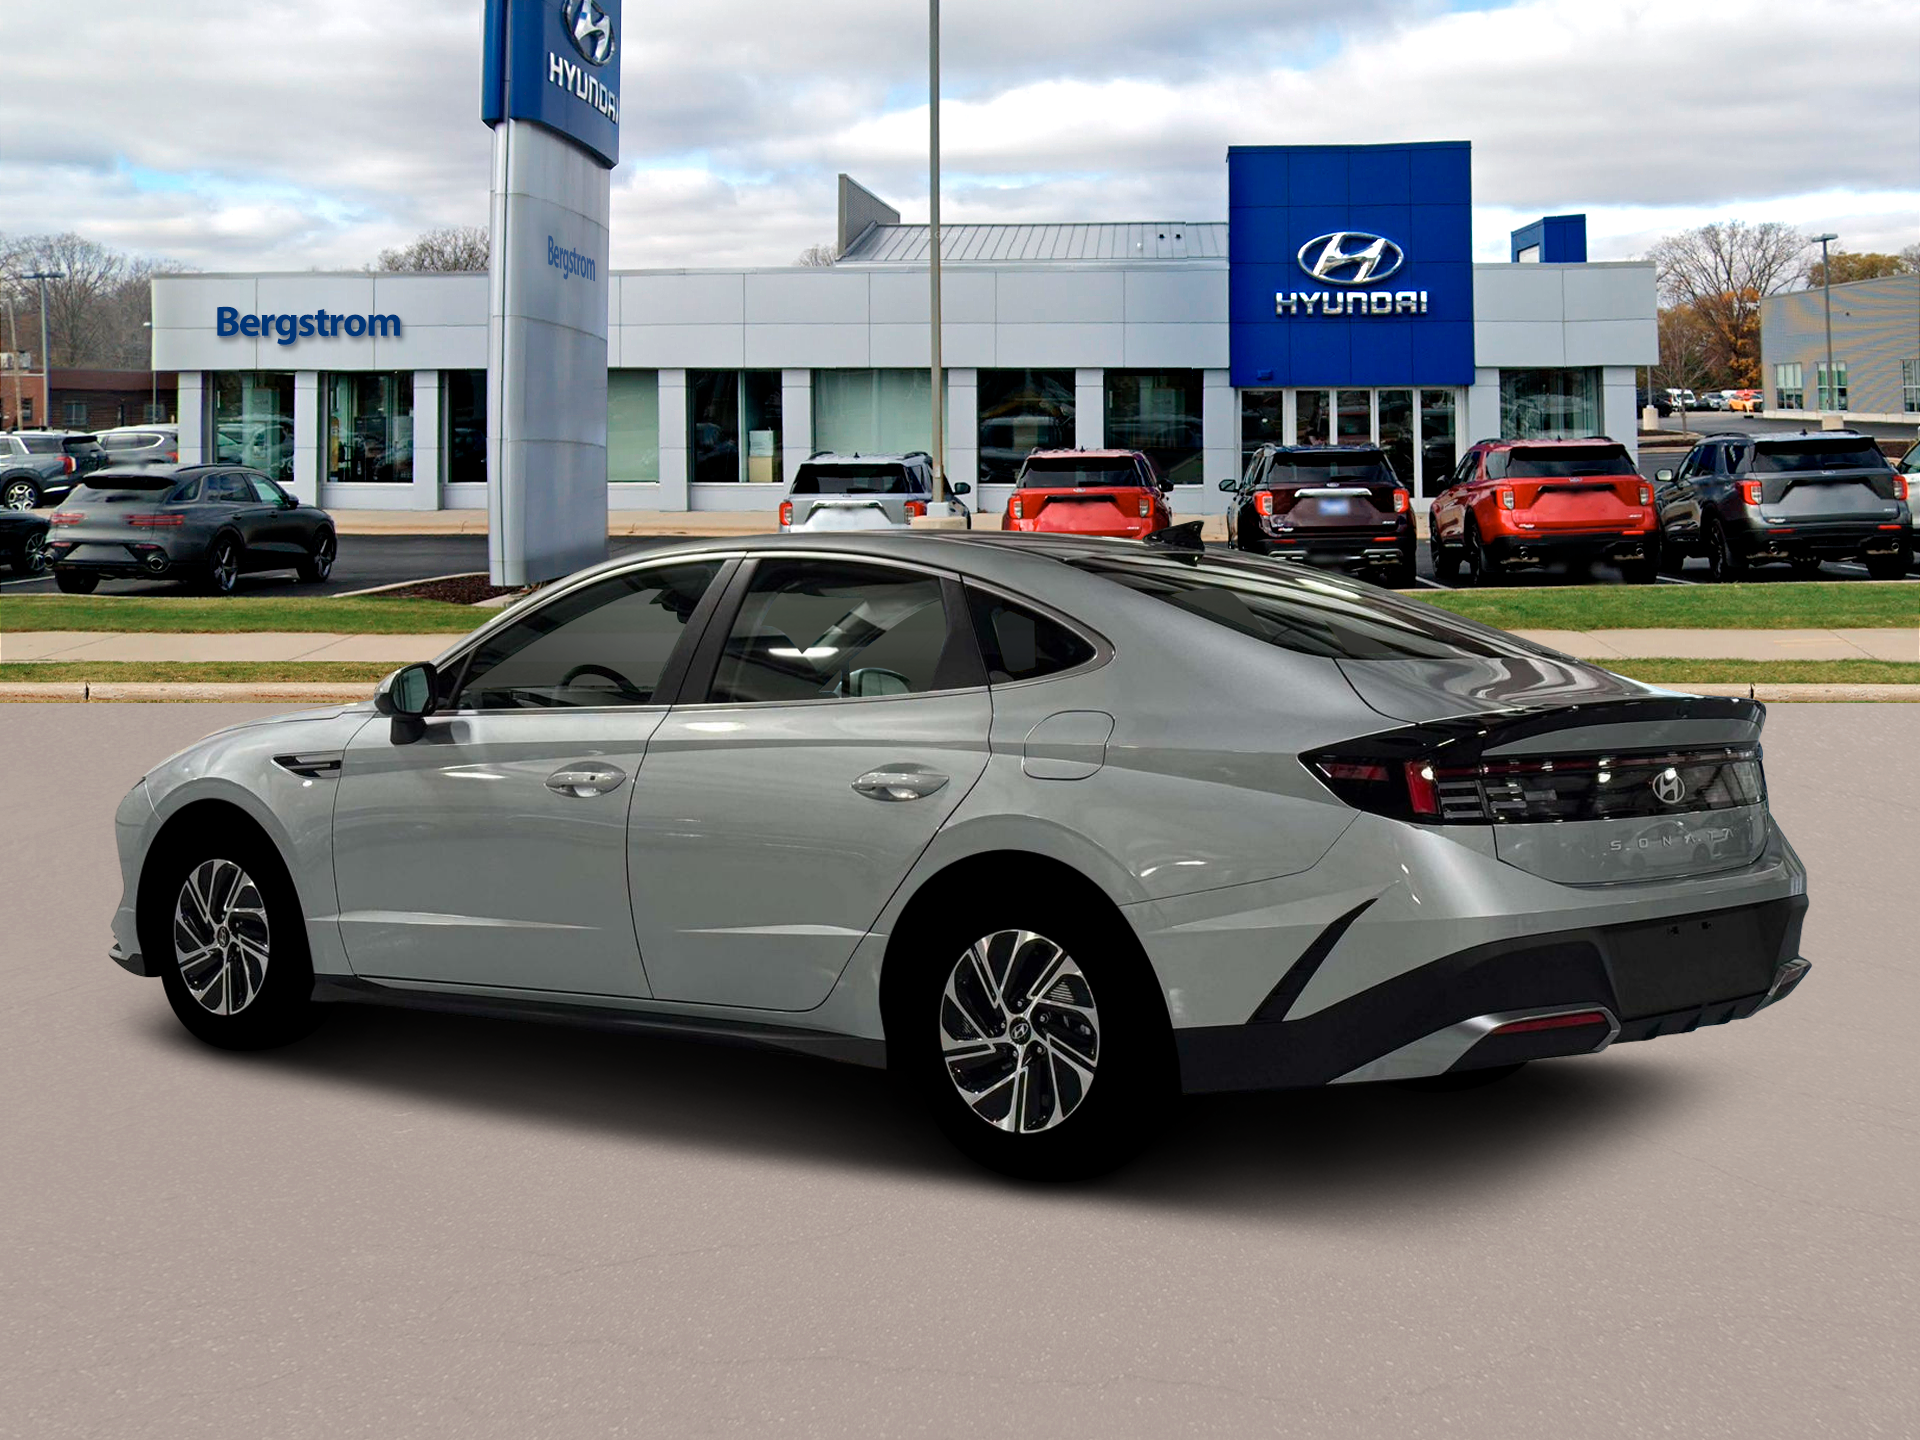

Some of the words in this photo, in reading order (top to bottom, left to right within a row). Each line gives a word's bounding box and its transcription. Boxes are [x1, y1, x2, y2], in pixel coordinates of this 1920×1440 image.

[548, 52, 618, 123] HYUNDAI
[547, 235, 596, 281] Bergstrom
[1275, 291, 1429, 316] HYUNDAI
[216, 306, 402, 345] Bergstrom
[1610, 827, 1734, 850] SONATA
